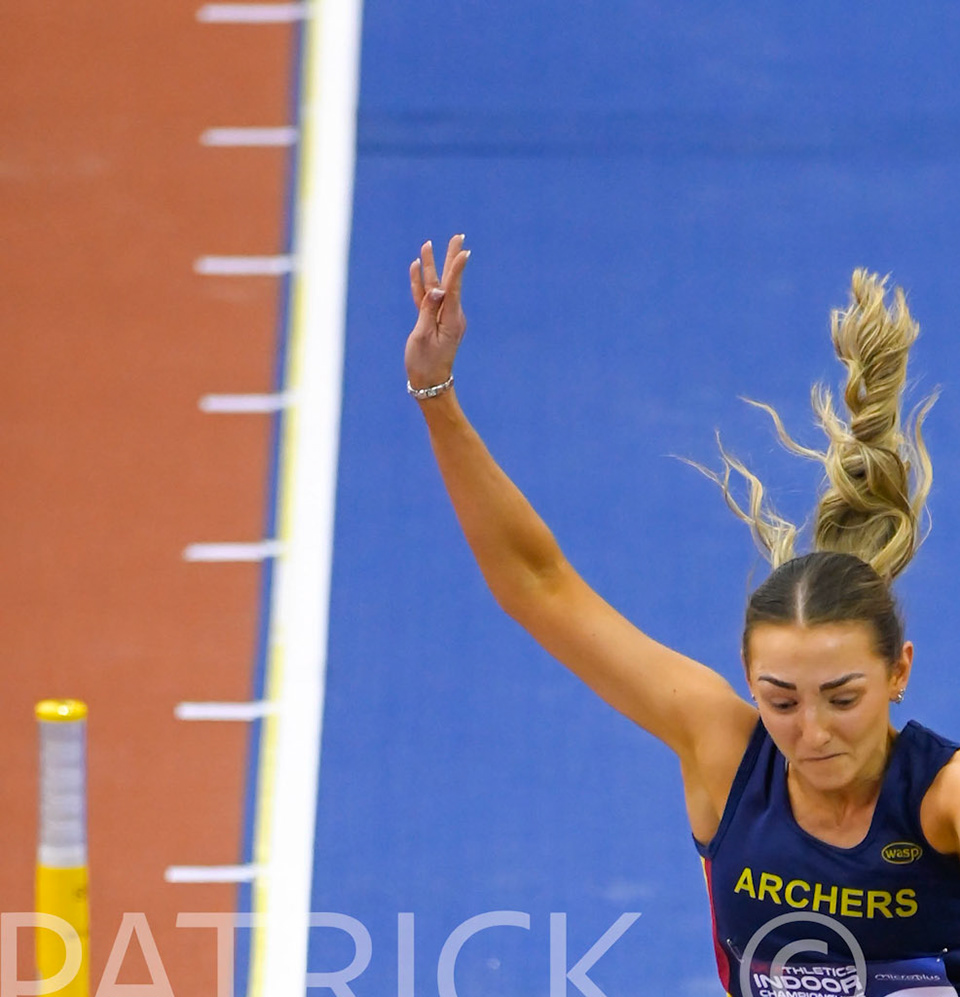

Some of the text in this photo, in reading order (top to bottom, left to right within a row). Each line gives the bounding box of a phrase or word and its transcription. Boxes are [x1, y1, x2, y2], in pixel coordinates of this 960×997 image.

[884, 848, 920, 862] wasp
[734, 867, 919, 919] ARCHERS
[753, 973, 863, 994] INDOOR
